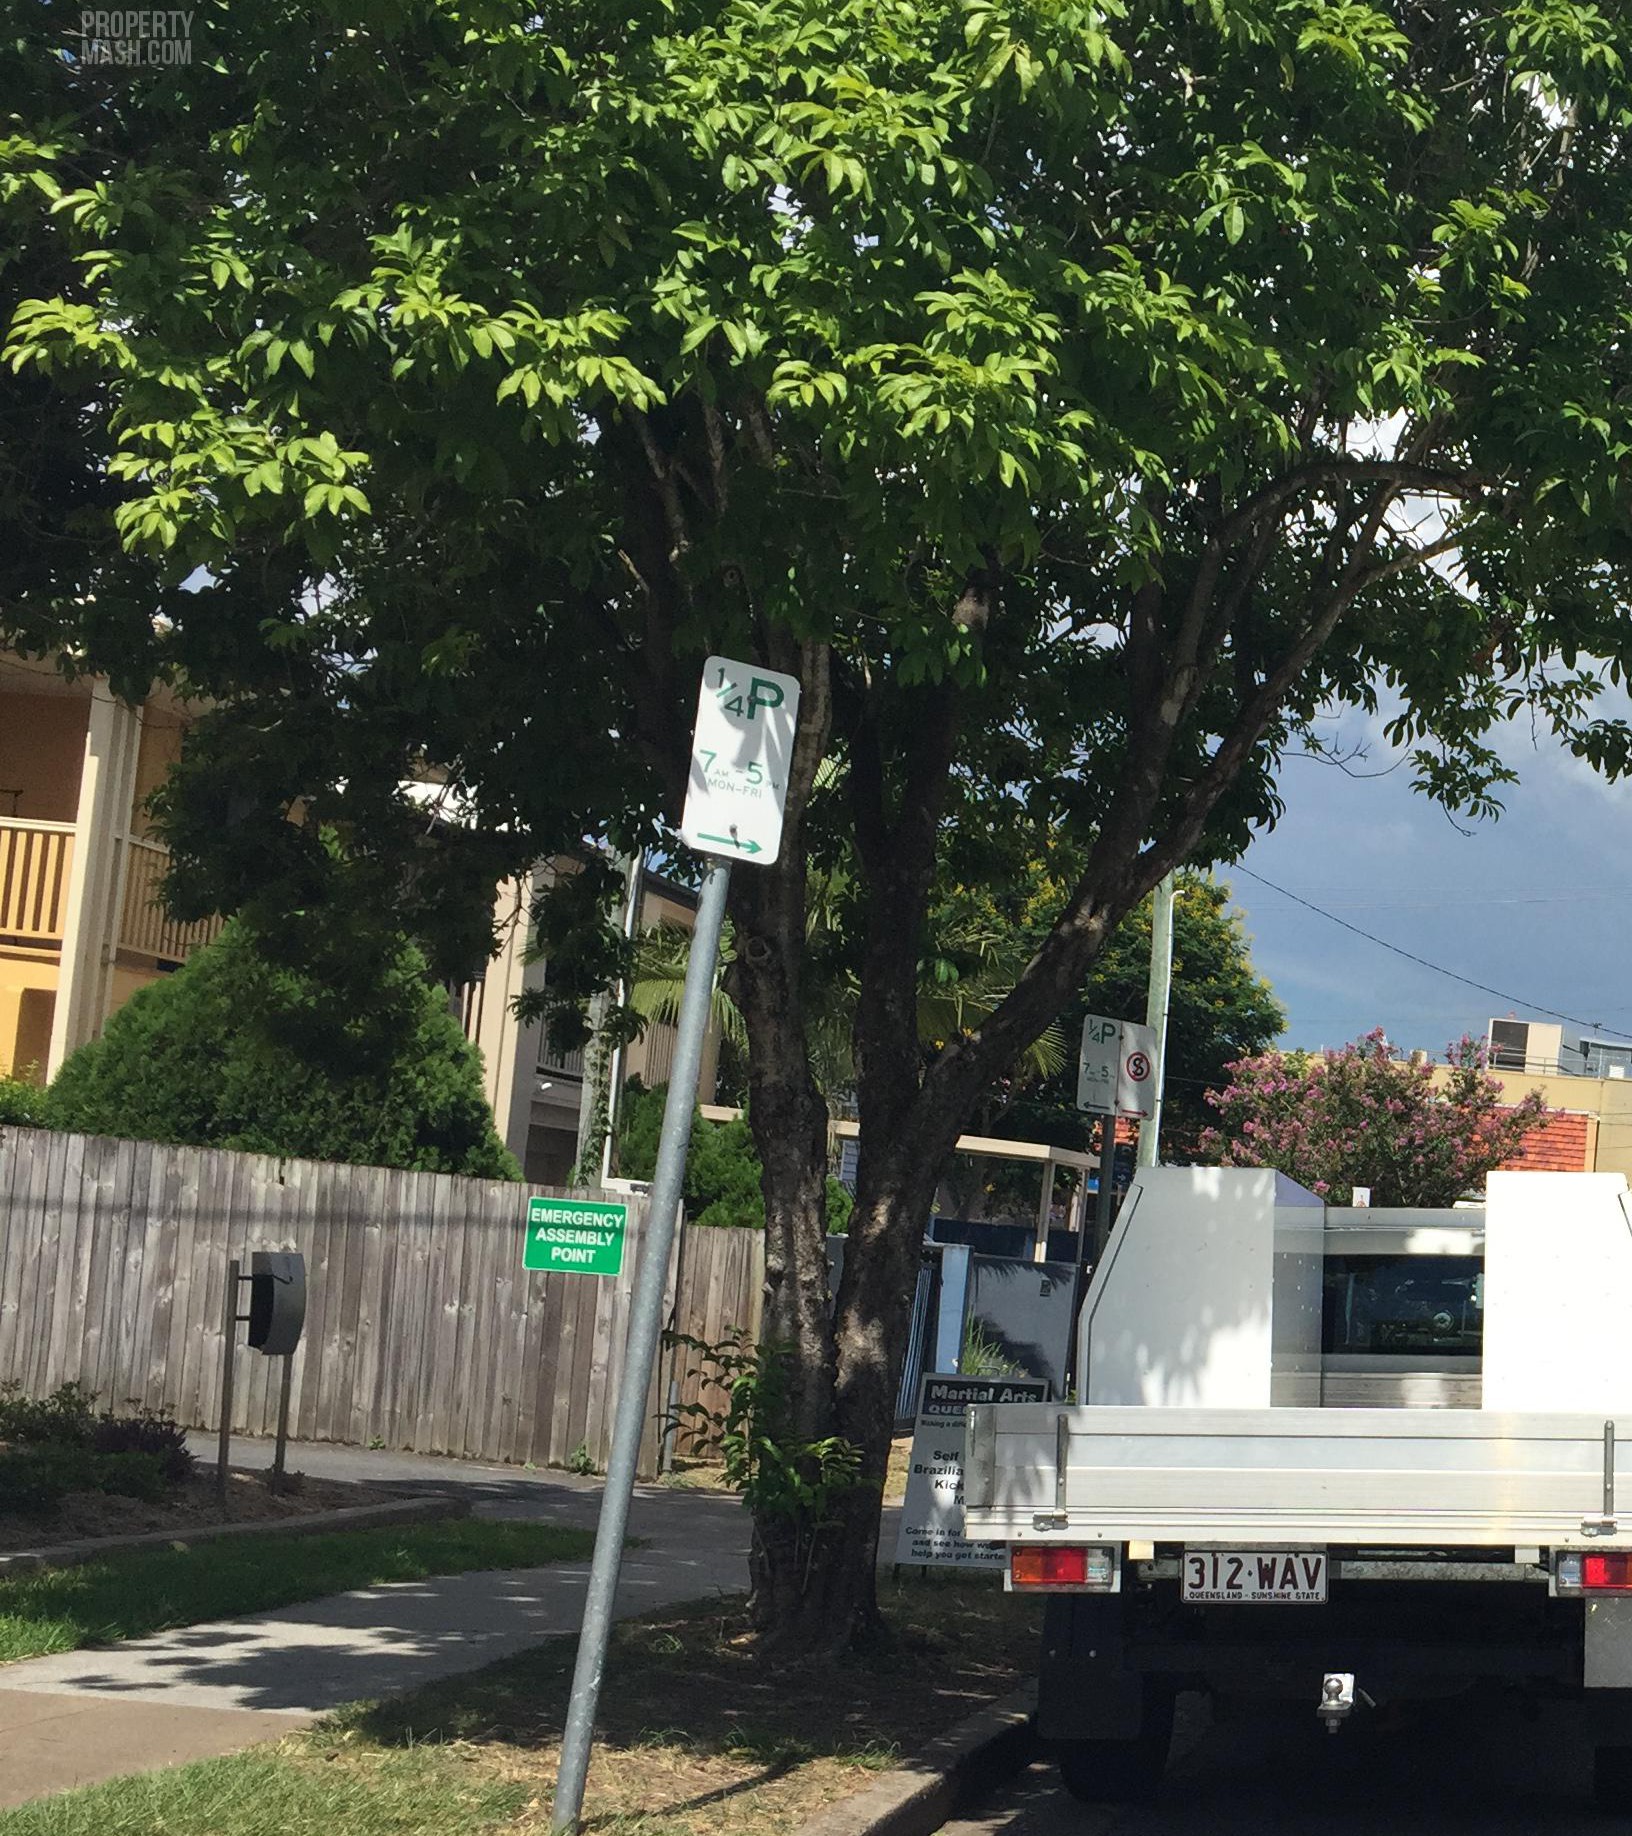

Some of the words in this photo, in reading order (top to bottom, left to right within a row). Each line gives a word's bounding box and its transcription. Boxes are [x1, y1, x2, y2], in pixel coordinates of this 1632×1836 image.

[531, 1207, 624, 1228] EMERGENCY
[535, 1227, 615, 1247] ASSEMBLY
[551, 1246, 596, 1263] POINT
[930, 1384, 995, 1401] Martial
[1000, 1387, 1038, 1403] Arts
[933, 1450, 960, 1462] Self
[905, 1526, 934, 1536] Come
[954, 1540, 974, 1549] how
[911, 1549, 933, 1559] help
[935, 1551, 953, 1560] you
[1189, 1591, 1243, 1600] QUEENSLAND
[1251, 1592, 1292, 1600] SUNSHINE
[1295, 1592, 1320, 1600] STATE
